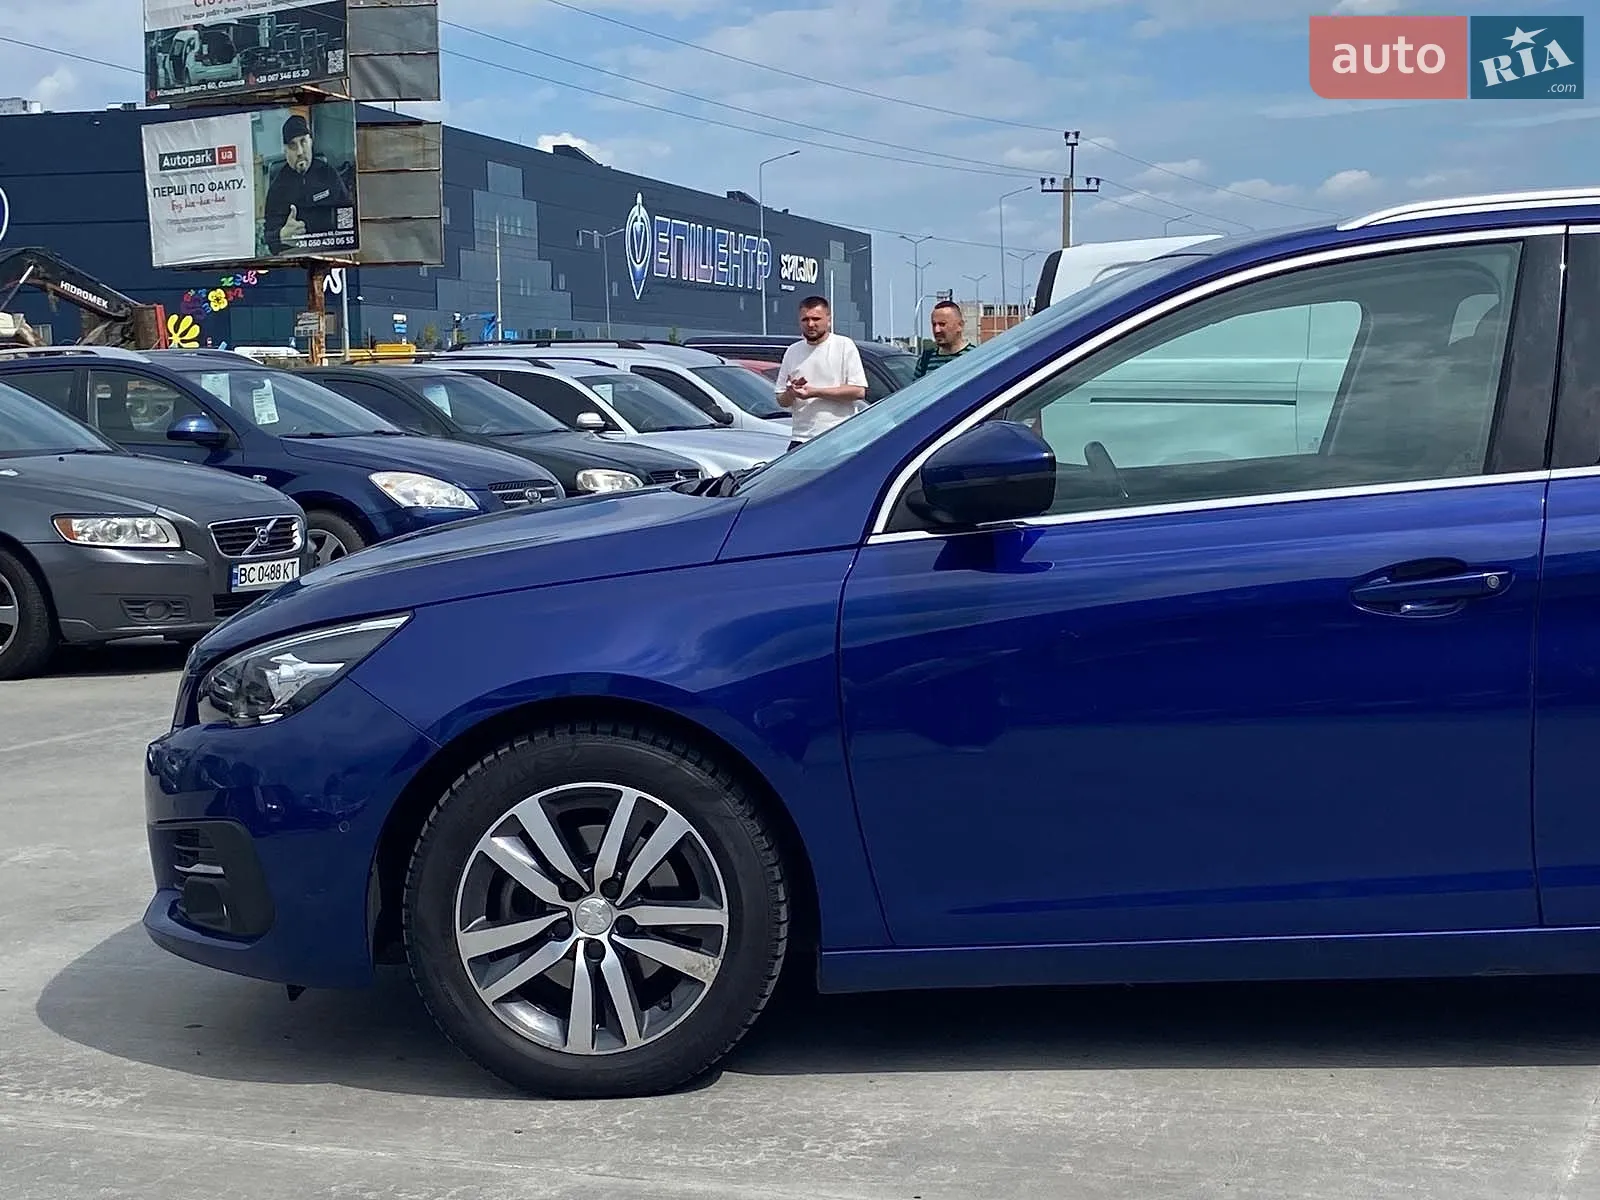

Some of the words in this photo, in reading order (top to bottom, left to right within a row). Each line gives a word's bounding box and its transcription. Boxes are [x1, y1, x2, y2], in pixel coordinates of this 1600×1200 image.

[301, 69, 310, 77] 20
[162, 150, 212, 167] Autopark
[221, 151, 233, 160] ua
[153, 185, 187, 198] ПЕРШІ
[190, 183, 205, 194] ПО
[208, 178, 246, 192] ФАКТУ.
[653, 215, 773, 290] ЕПІЦЕНТР
[60, 280, 109, 309] HIDROMEK
[239, 567, 256, 585] BC
[258, 564, 281, 583] 0488
[283, 561, 297, 580] KT
